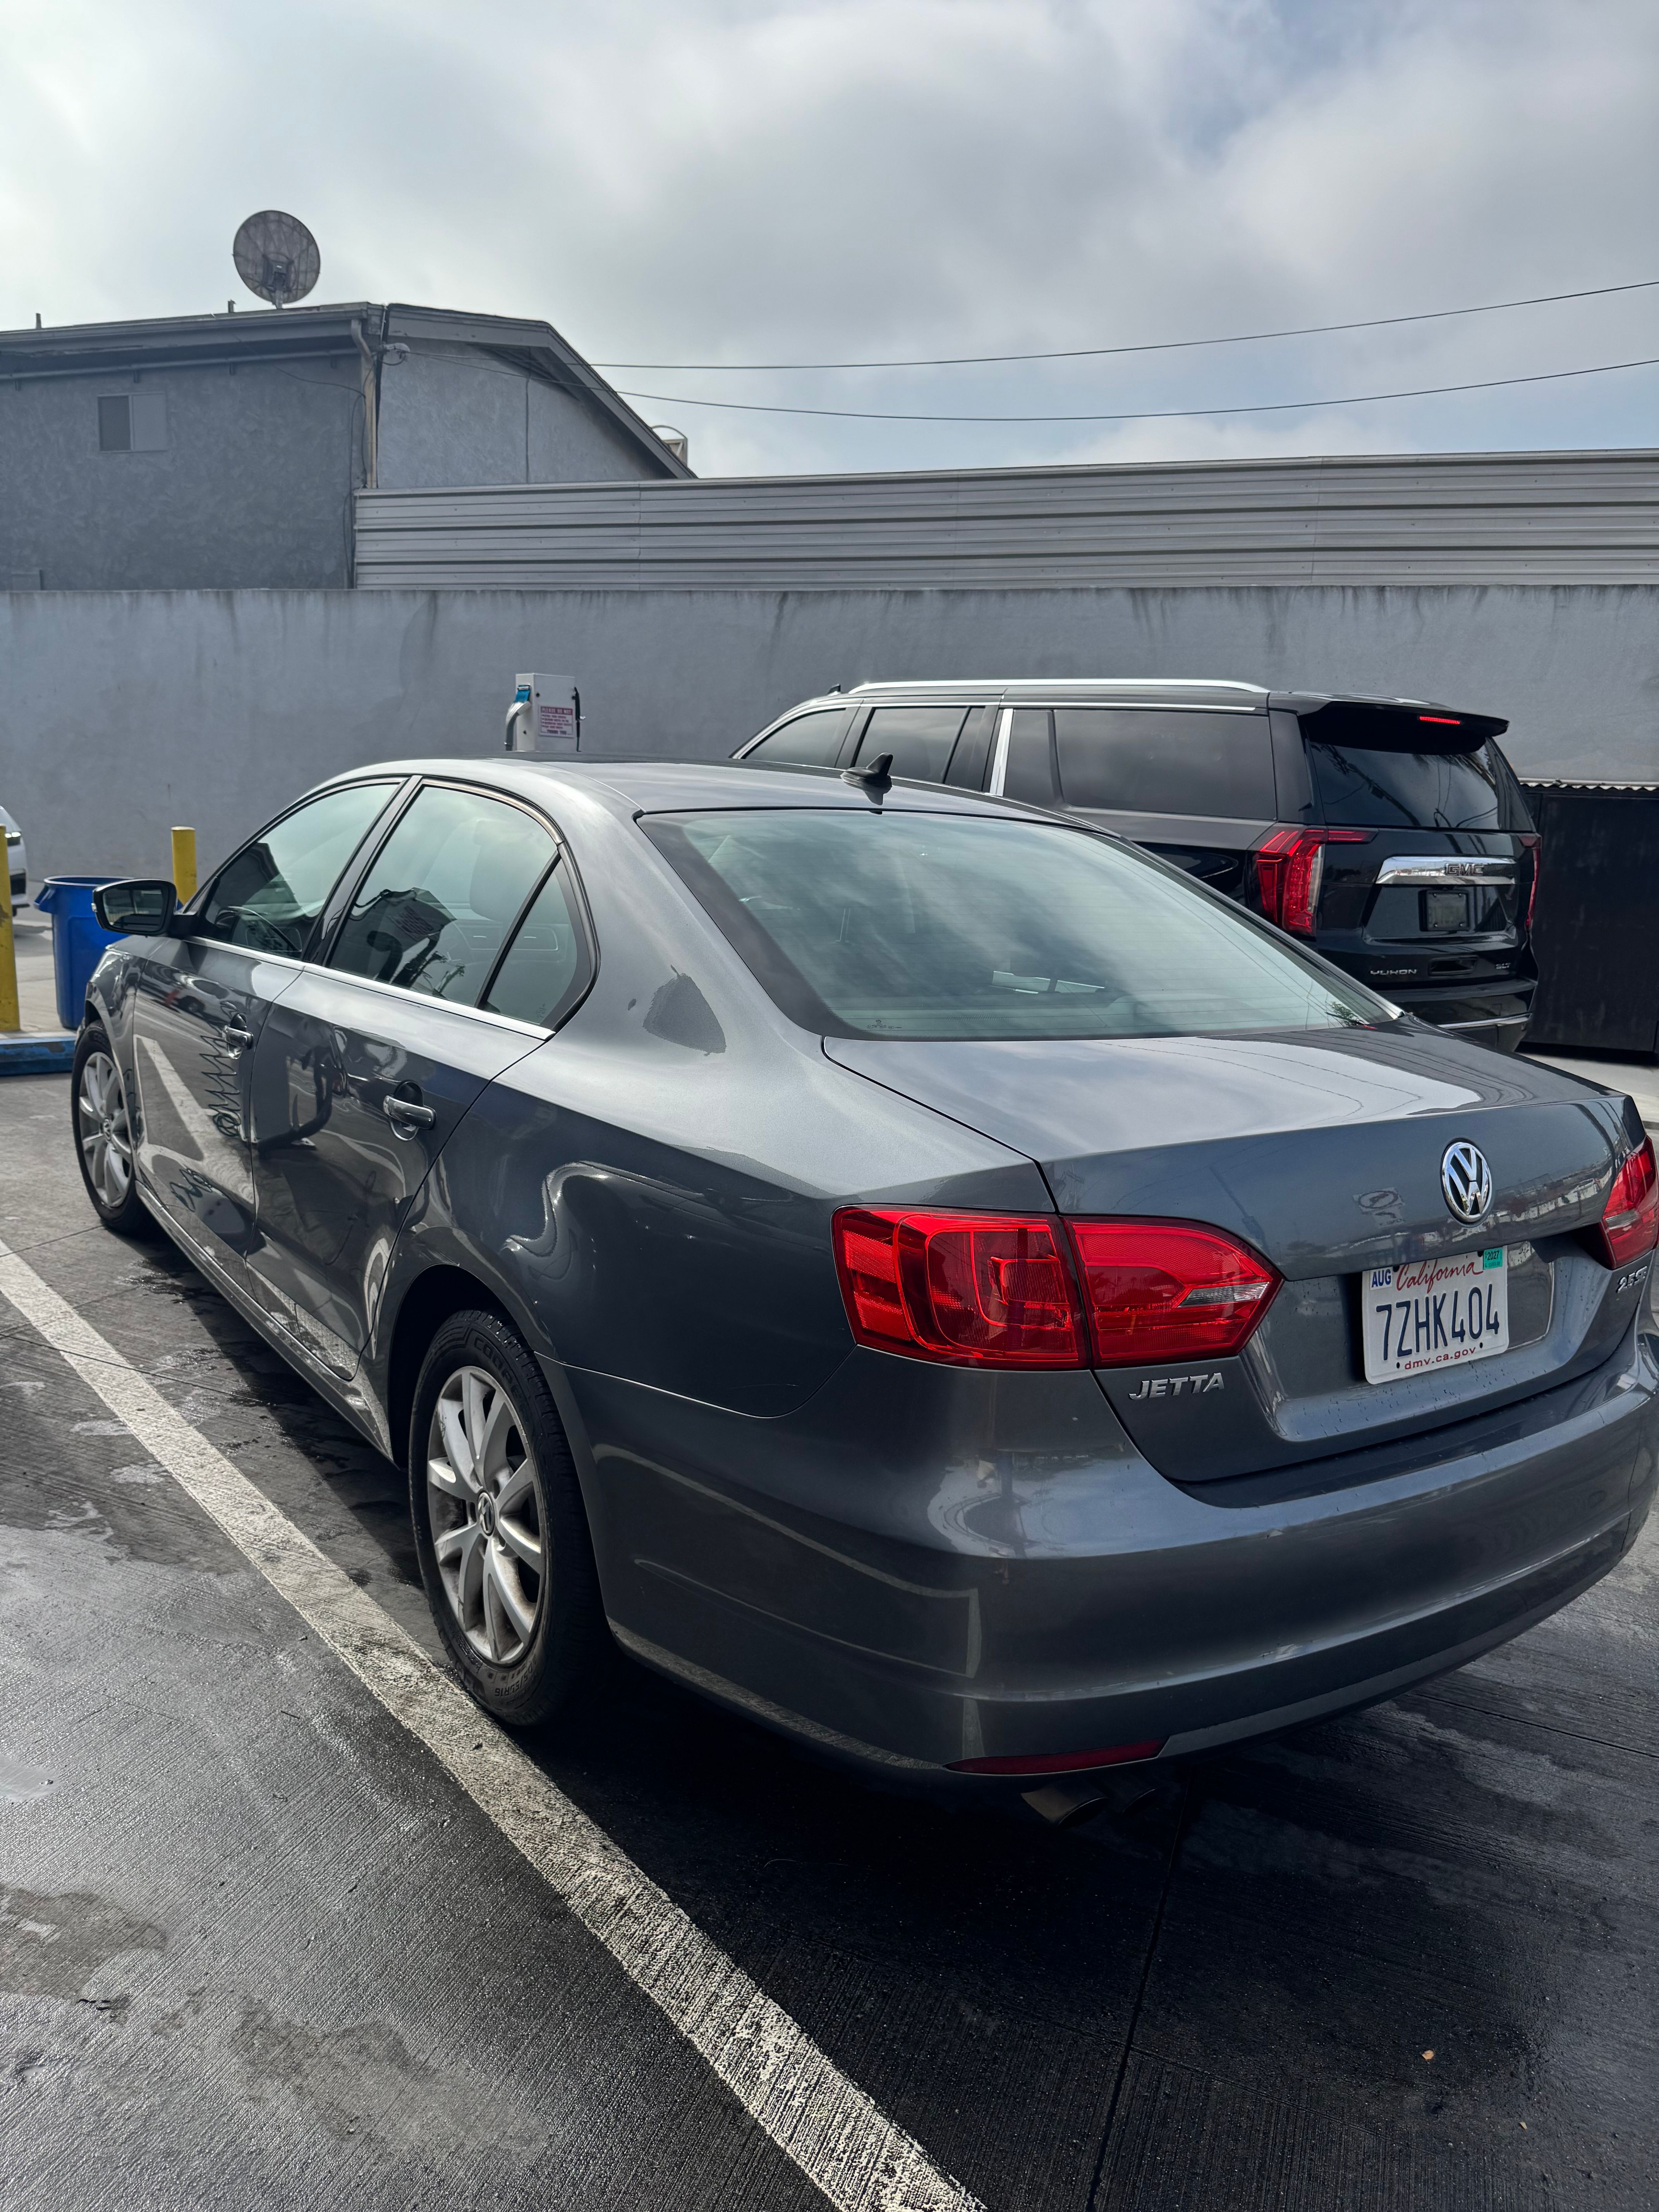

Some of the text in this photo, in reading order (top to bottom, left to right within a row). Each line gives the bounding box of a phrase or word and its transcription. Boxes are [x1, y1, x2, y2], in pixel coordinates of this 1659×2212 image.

[1445, 863, 1484, 876] GMC
[1487, 1250, 1500, 1261] 2027
[1371, 1269, 1391, 1288] AUG
[1396, 1259, 1484, 1293] California
[1376, 1284, 1499, 1361] 7ZHK404
[1404, 1347, 1476, 1370] dmv.ca.gov
[1128, 1372, 1224, 1400] JETTA
